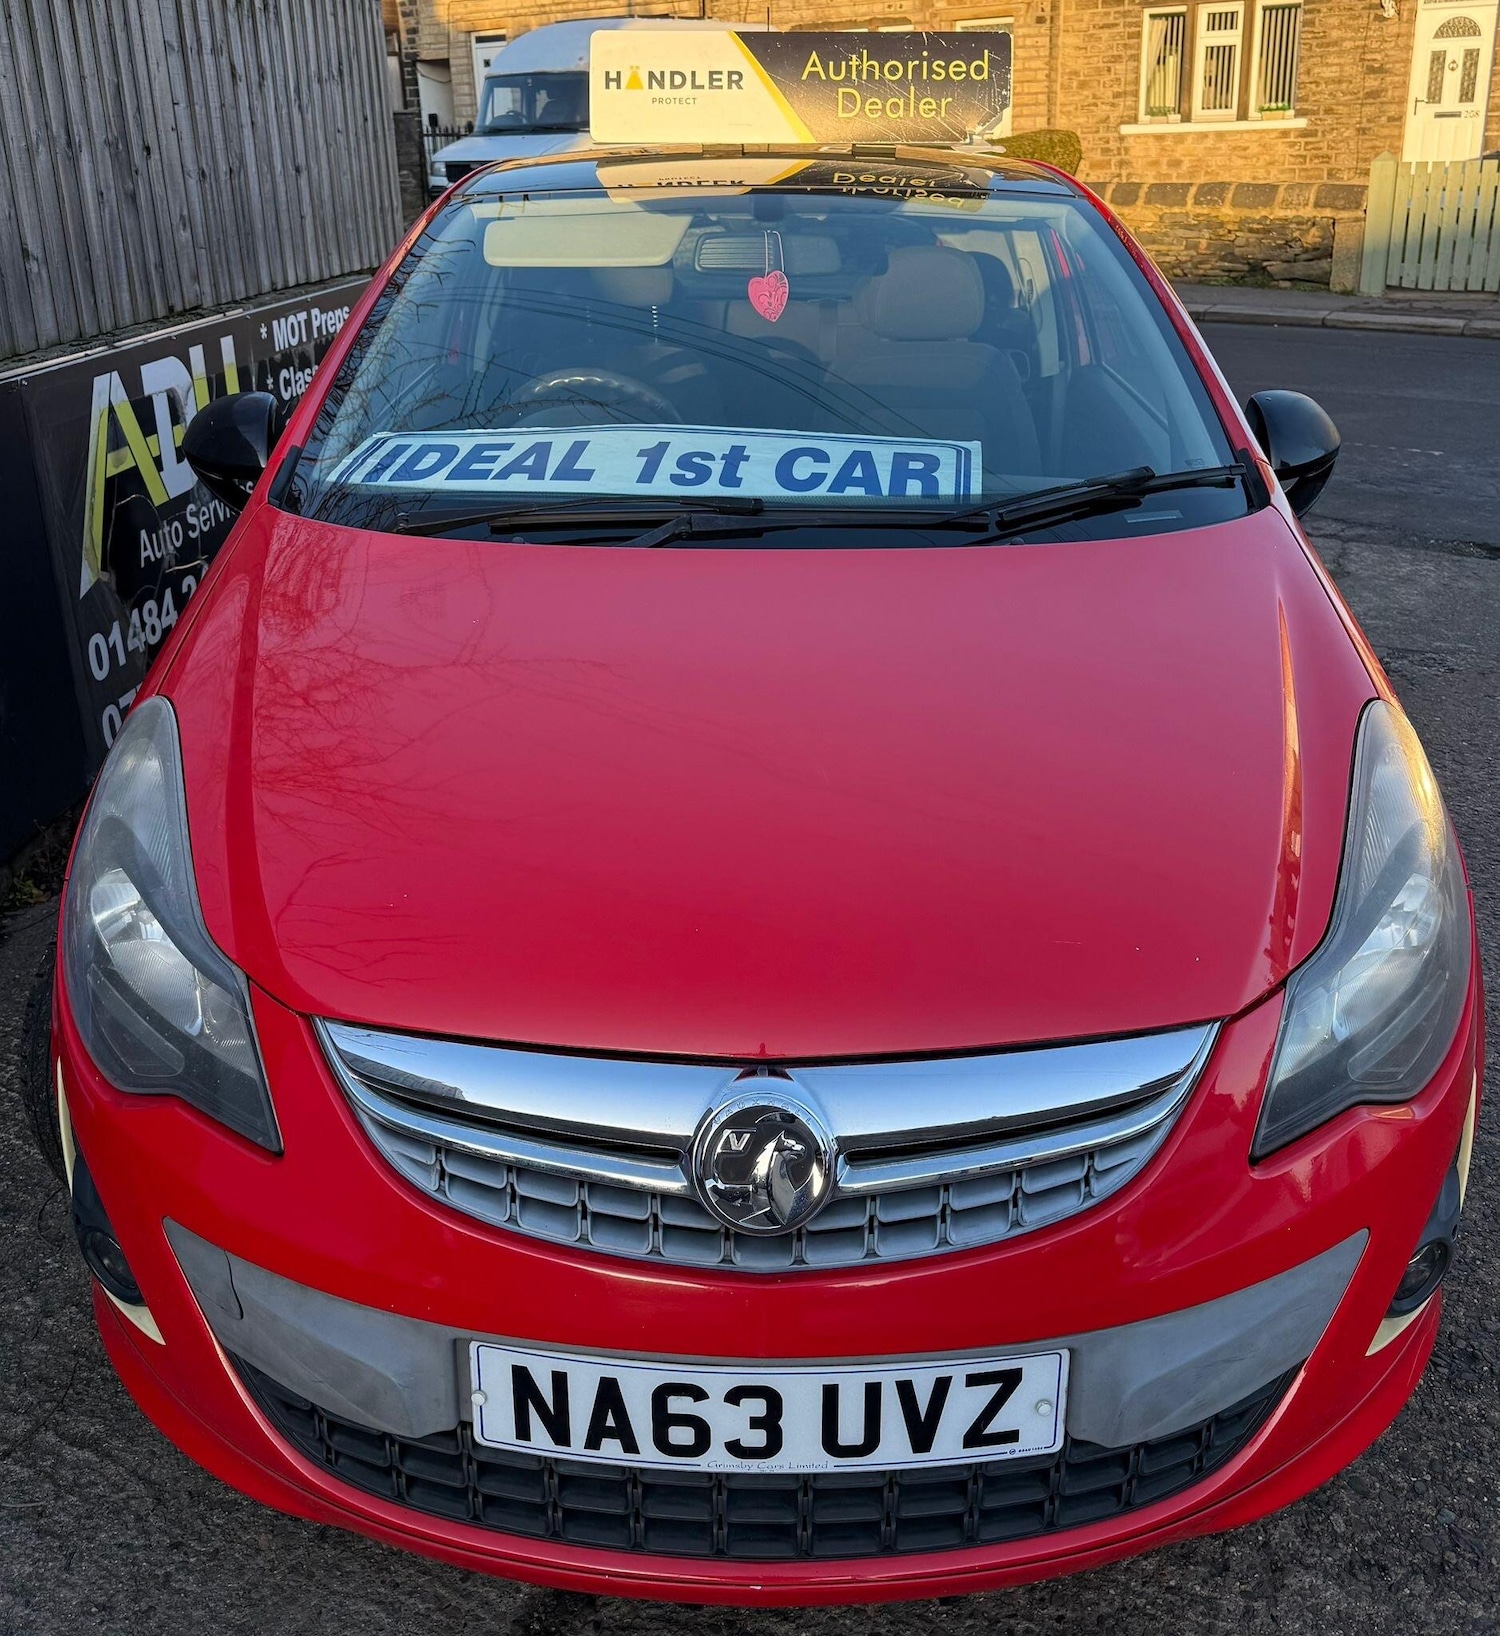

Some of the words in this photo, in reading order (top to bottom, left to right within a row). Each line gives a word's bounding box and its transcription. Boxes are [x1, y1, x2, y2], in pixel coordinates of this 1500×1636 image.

[801, 49, 989, 81] Authorised
[651, 97, 697, 105] PROTECT
[837, 85, 953, 118] Dealer
[272, 310, 308, 352] MOT
[361, 440, 596, 483] IDEAL
[635, 441, 751, 488] 1st
[775, 447, 941, 497] CAR
[140, 518, 184, 568] Auto
[88, 587, 179, 682] 01484
[511, 1364, 783, 1460] NA63
[821, 1367, 1023, 1458] UVZ
[707, 1460, 754, 1471] Grimsby
[757, 1461, 785, 1470] Cars
[788, 1460, 828, 1470] Limited
